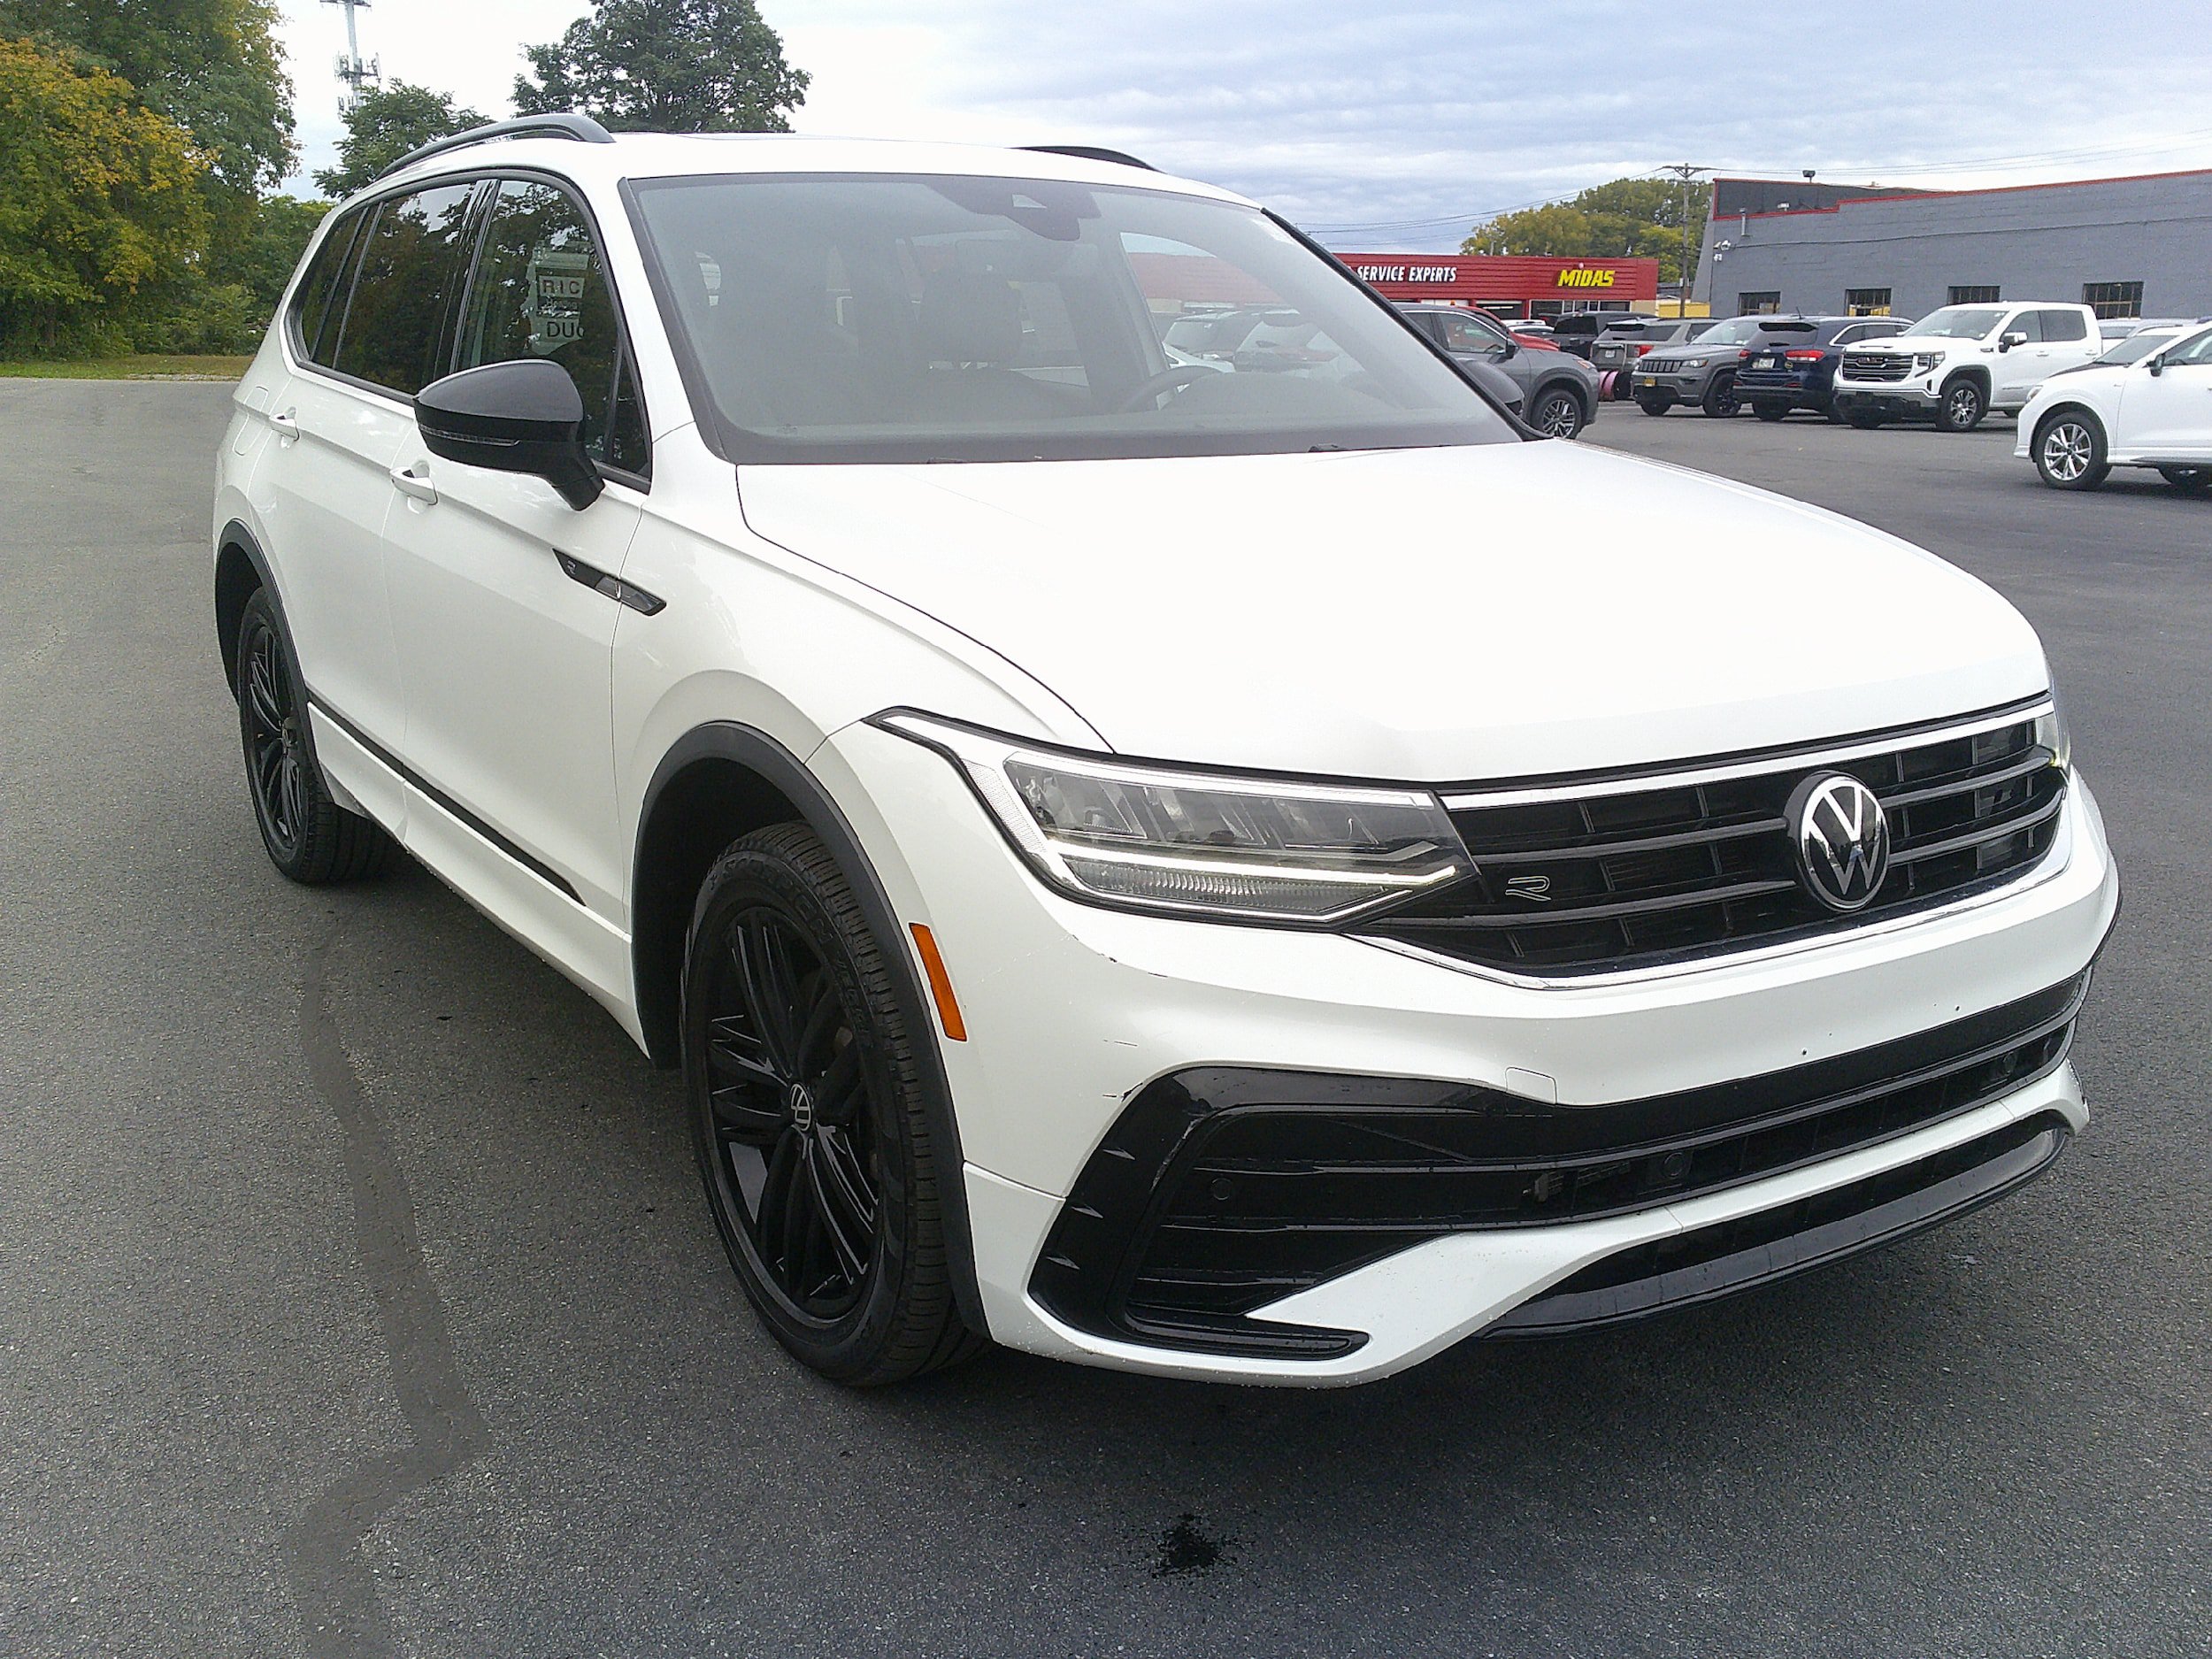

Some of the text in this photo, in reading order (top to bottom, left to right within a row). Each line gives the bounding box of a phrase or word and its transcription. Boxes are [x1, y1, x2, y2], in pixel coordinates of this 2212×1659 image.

[1357, 265, 1456, 281] SERVICE EXPERTS
[1557, 269, 1616, 287] MIDAS
[1505, 875, 1552, 902] R
